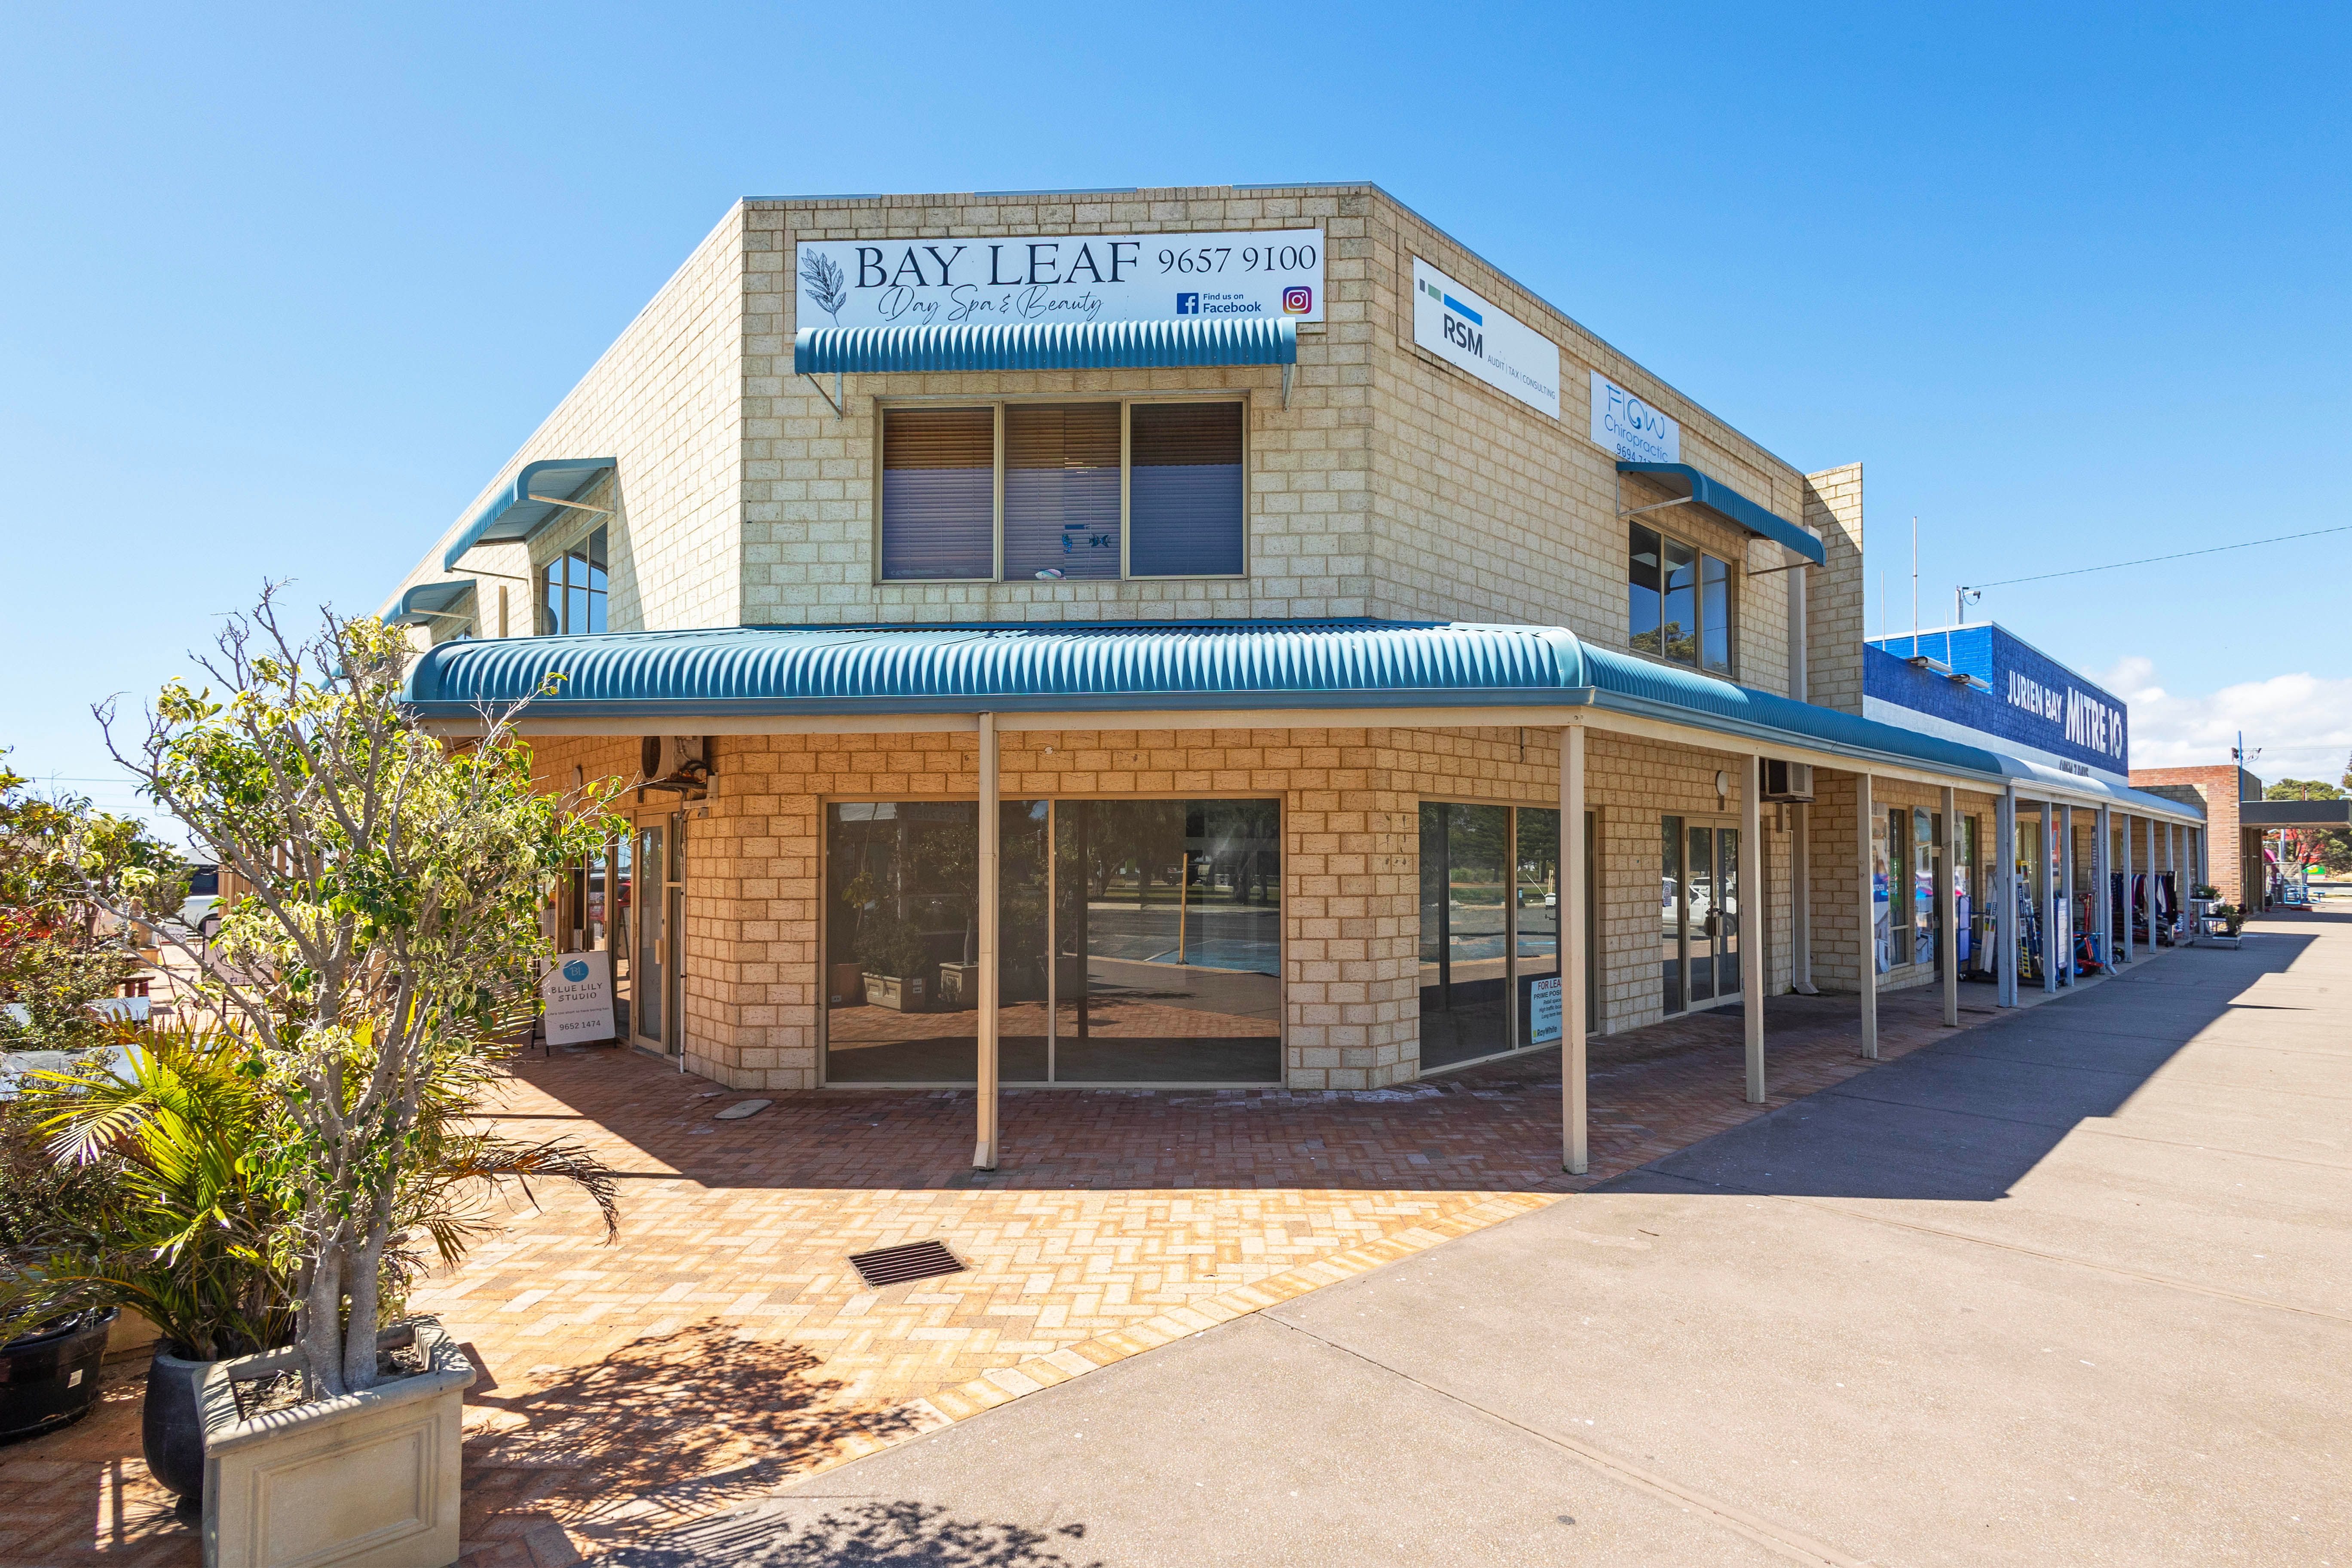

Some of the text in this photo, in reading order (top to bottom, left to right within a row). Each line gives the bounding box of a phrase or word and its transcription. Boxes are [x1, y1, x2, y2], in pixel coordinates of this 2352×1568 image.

[855, 242, 1140, 288] BAY LEAF
[1158, 245, 1316, 274] 9657 9100
[879, 284, 1104, 325] Day Spa & Beauty
[1204, 301, 1262, 313] Facebook
[1444, 313, 1482, 358] RSM
[1487, 355, 1555, 399] AUDIT TAX CONSULTING
[1605, 414, 1668, 462] Chiropractic
[1617, 443, 1635, 462] 9694
[2007, 670, 2062, 723] JURIEN BAY
[2065, 686, 2122, 759] MITRE 10
[551, 985, 577, 993] BLUE
[558, 992, 597, 1002] STUDIO
[1534, 992, 1548, 1000] PRIME
[1538, 979, 1562, 990] FOR LEA
[560, 1020, 601, 1031] 9652 1474
